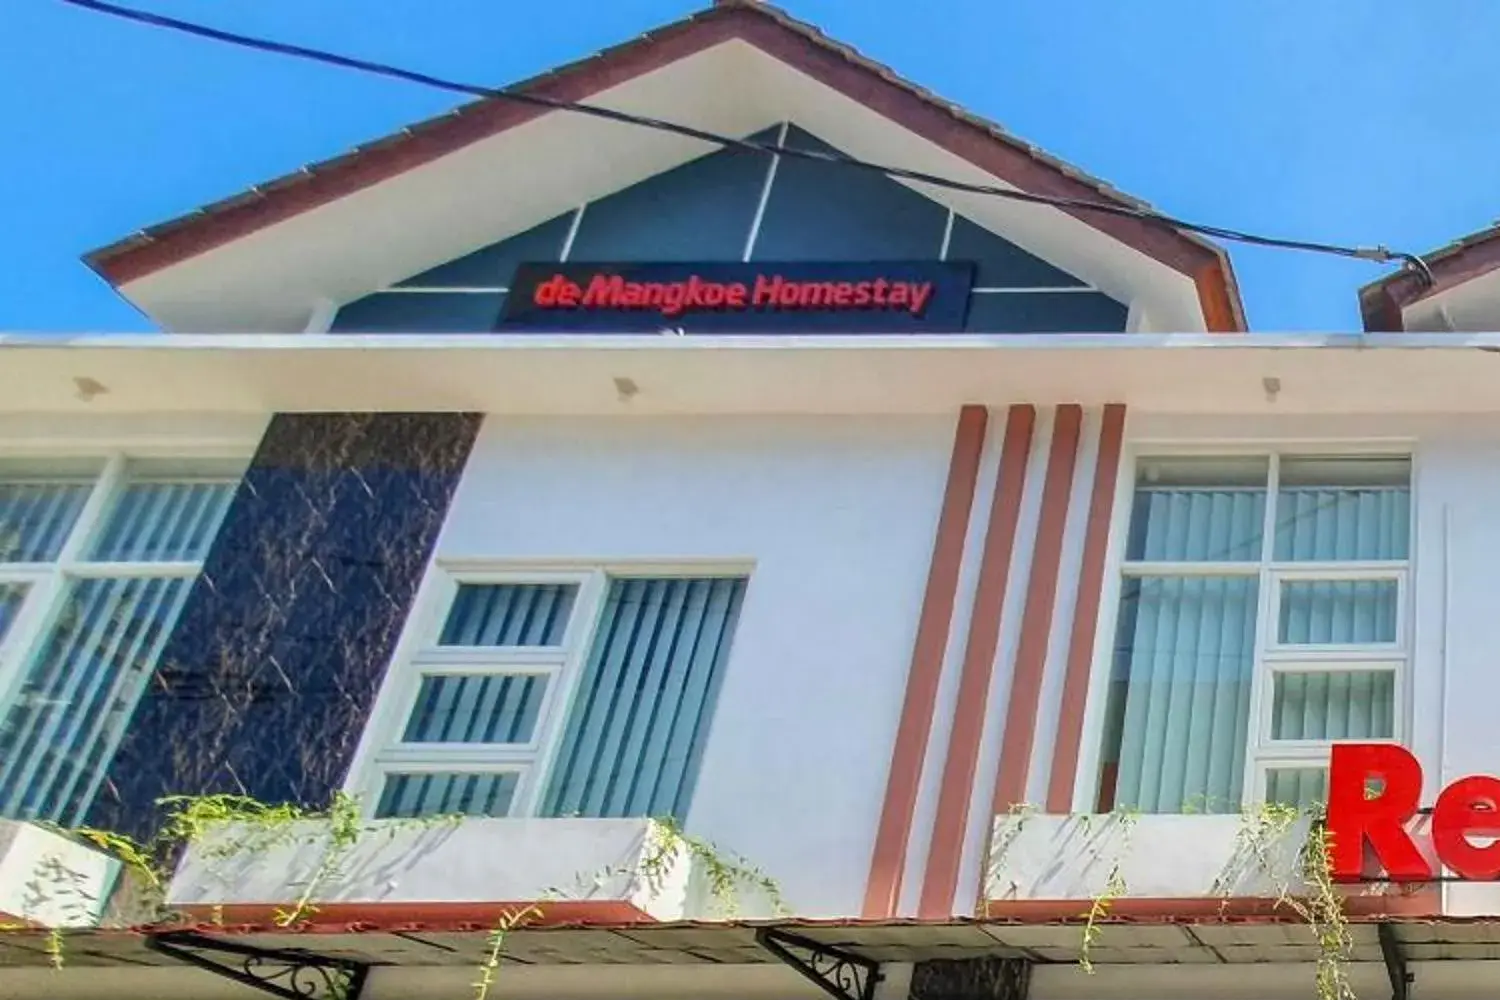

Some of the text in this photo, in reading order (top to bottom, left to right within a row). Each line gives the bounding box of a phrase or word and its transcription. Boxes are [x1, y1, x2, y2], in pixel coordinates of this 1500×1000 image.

[533, 273, 932, 314] de Mangkoe Homestay
